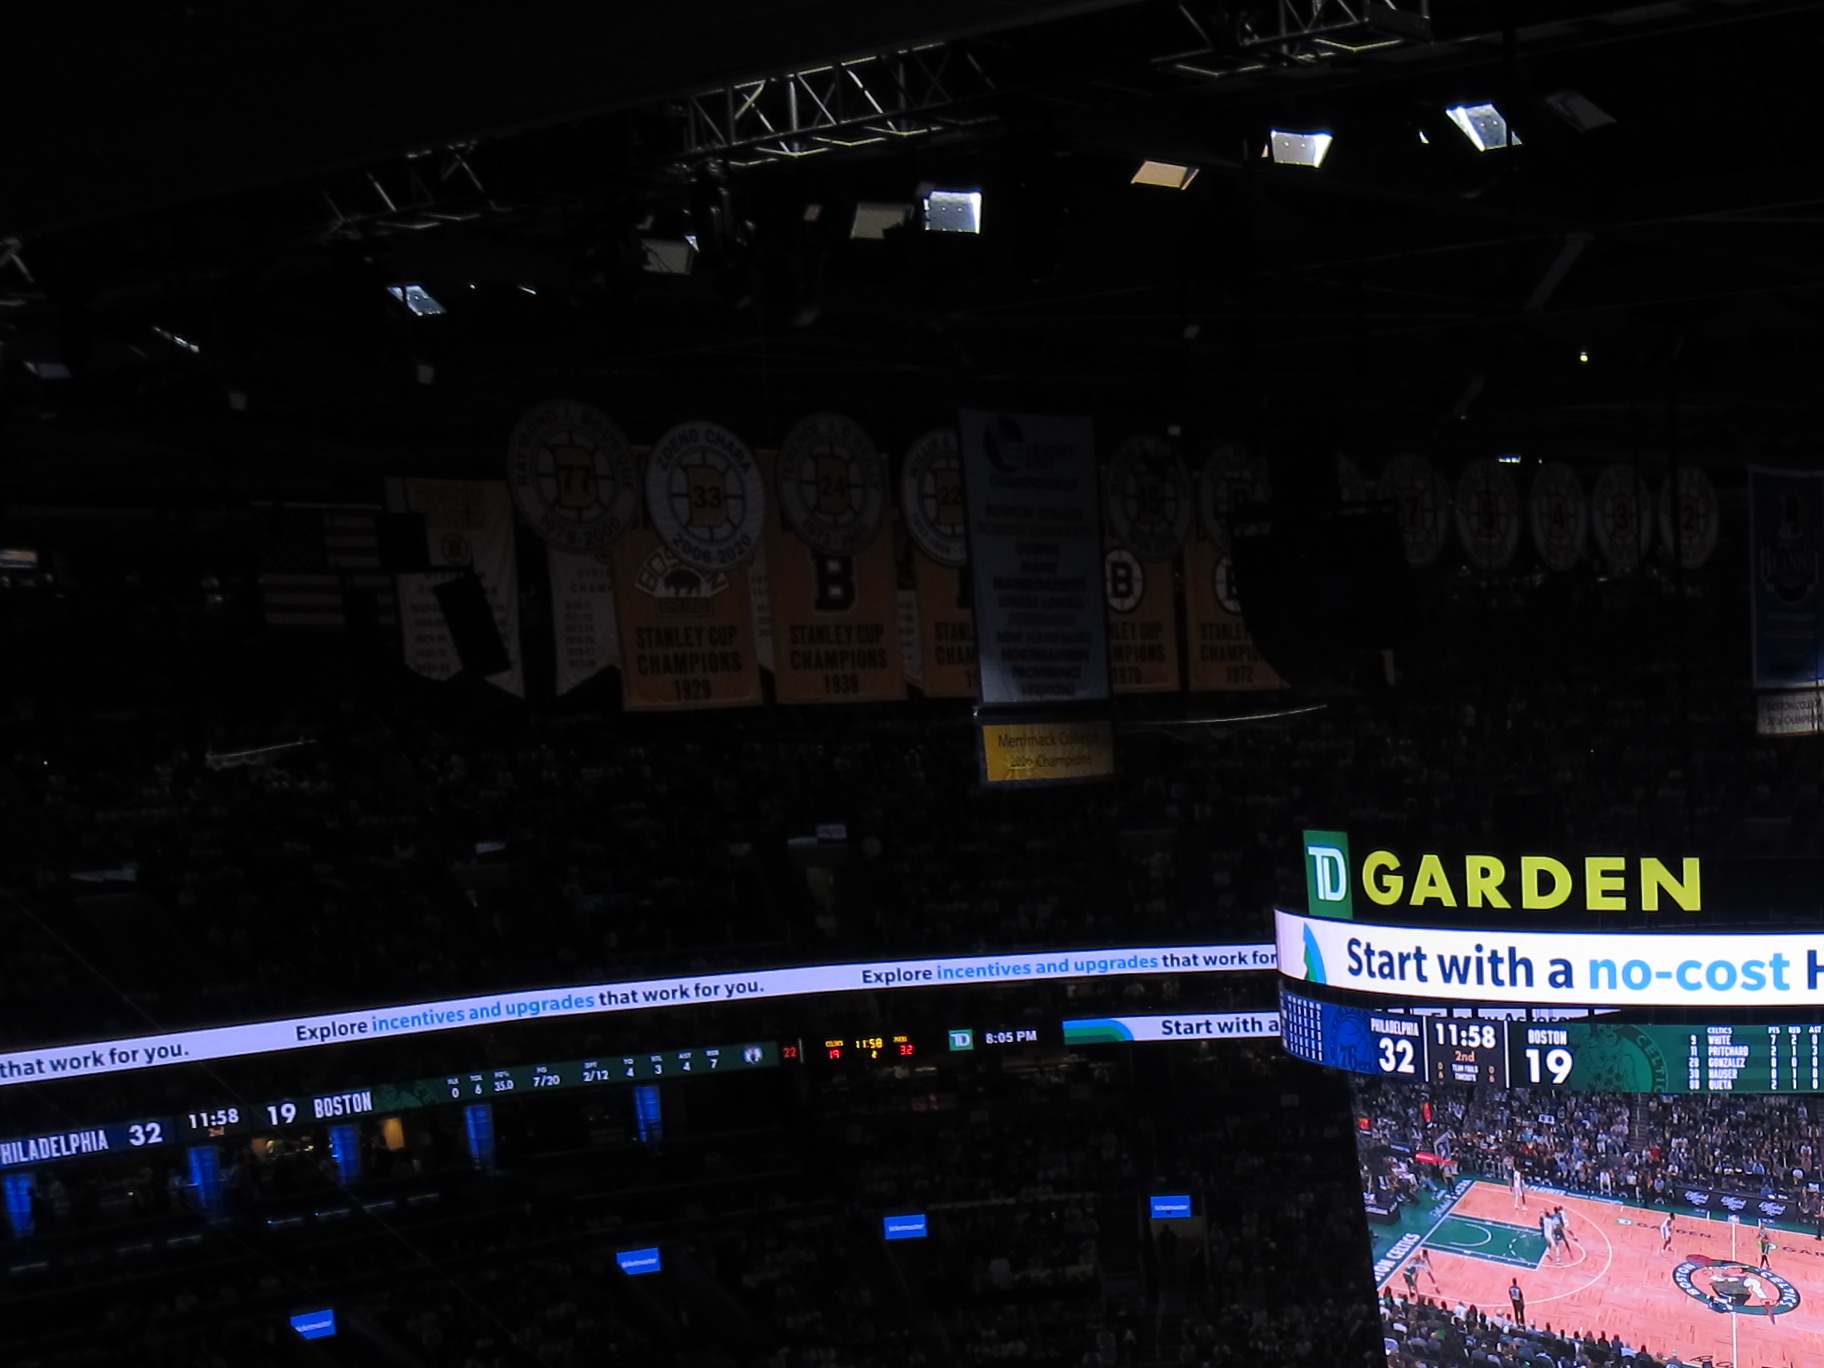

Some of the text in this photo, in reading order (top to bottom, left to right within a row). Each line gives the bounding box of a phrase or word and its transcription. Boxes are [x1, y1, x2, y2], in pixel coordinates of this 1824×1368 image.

[656, 429, 699, 471] ZDENO
[704, 430, 750, 475] CHARA
[563, 465, 592, 491] 77
[691, 485, 722, 509] 33
[635, 626, 737, 648] STANLEY CUP
[790, 624, 884, 645] STANLEY CUP
[637, 651, 743, 675] CHAMPIONS
[790, 649, 888, 671] CHAMPIONS
[673, 679, 711, 700] 1929
[823, 674, 859, 694] 1939
[1307, 846, 1701, 912] TD GARDEN
[862, 949, 1277, 988] Explore incentives and upgrades that work for
[1347, 937, 1428, 984] Start
[1437, 944, 1533, 989] with
[1548, 957, 1574, 989] a
[1589, 952, 1791, 992] no-cost
[295, 980, 764, 1043] Explore incentives and upgrades that work for you.
[985, 1030, 1038, 1044] 8:05 PM
[1161, 1016, 1280, 1036] Start with a
[1371, 1017, 1419, 1037] PHILADELPHIA
[1436, 1024, 1496, 1049] 11:58
[1527, 1029, 1568, 1046] BOSTON
[856, 1038, 883, 1050] 11:58
[951, 1033, 970, 1047] TD
[1708, 1046, 1749, 1056] PRITCHARD
[0, 1043, 190, 1079] that work for you.
[784, 1048, 796, 1058] 22
[1378, 1037, 1416, 1073] 32
[1455, 1051, 1475, 1063] 2nd
[533, 1075, 560, 1087] 7/20
[583, 1069, 609, 1082] 2/12
[711, 1058, 717, 1069] 7
[1525, 1048, 1574, 1085] 19
[267, 1103, 297, 1126] 19
[313, 1091, 373, 1119] BOSTON
[188, 1107, 239, 1129] 11:58
[129, 1123, 163, 1146] 32
[1, 1129, 108, 1166] HILADELPHIA
